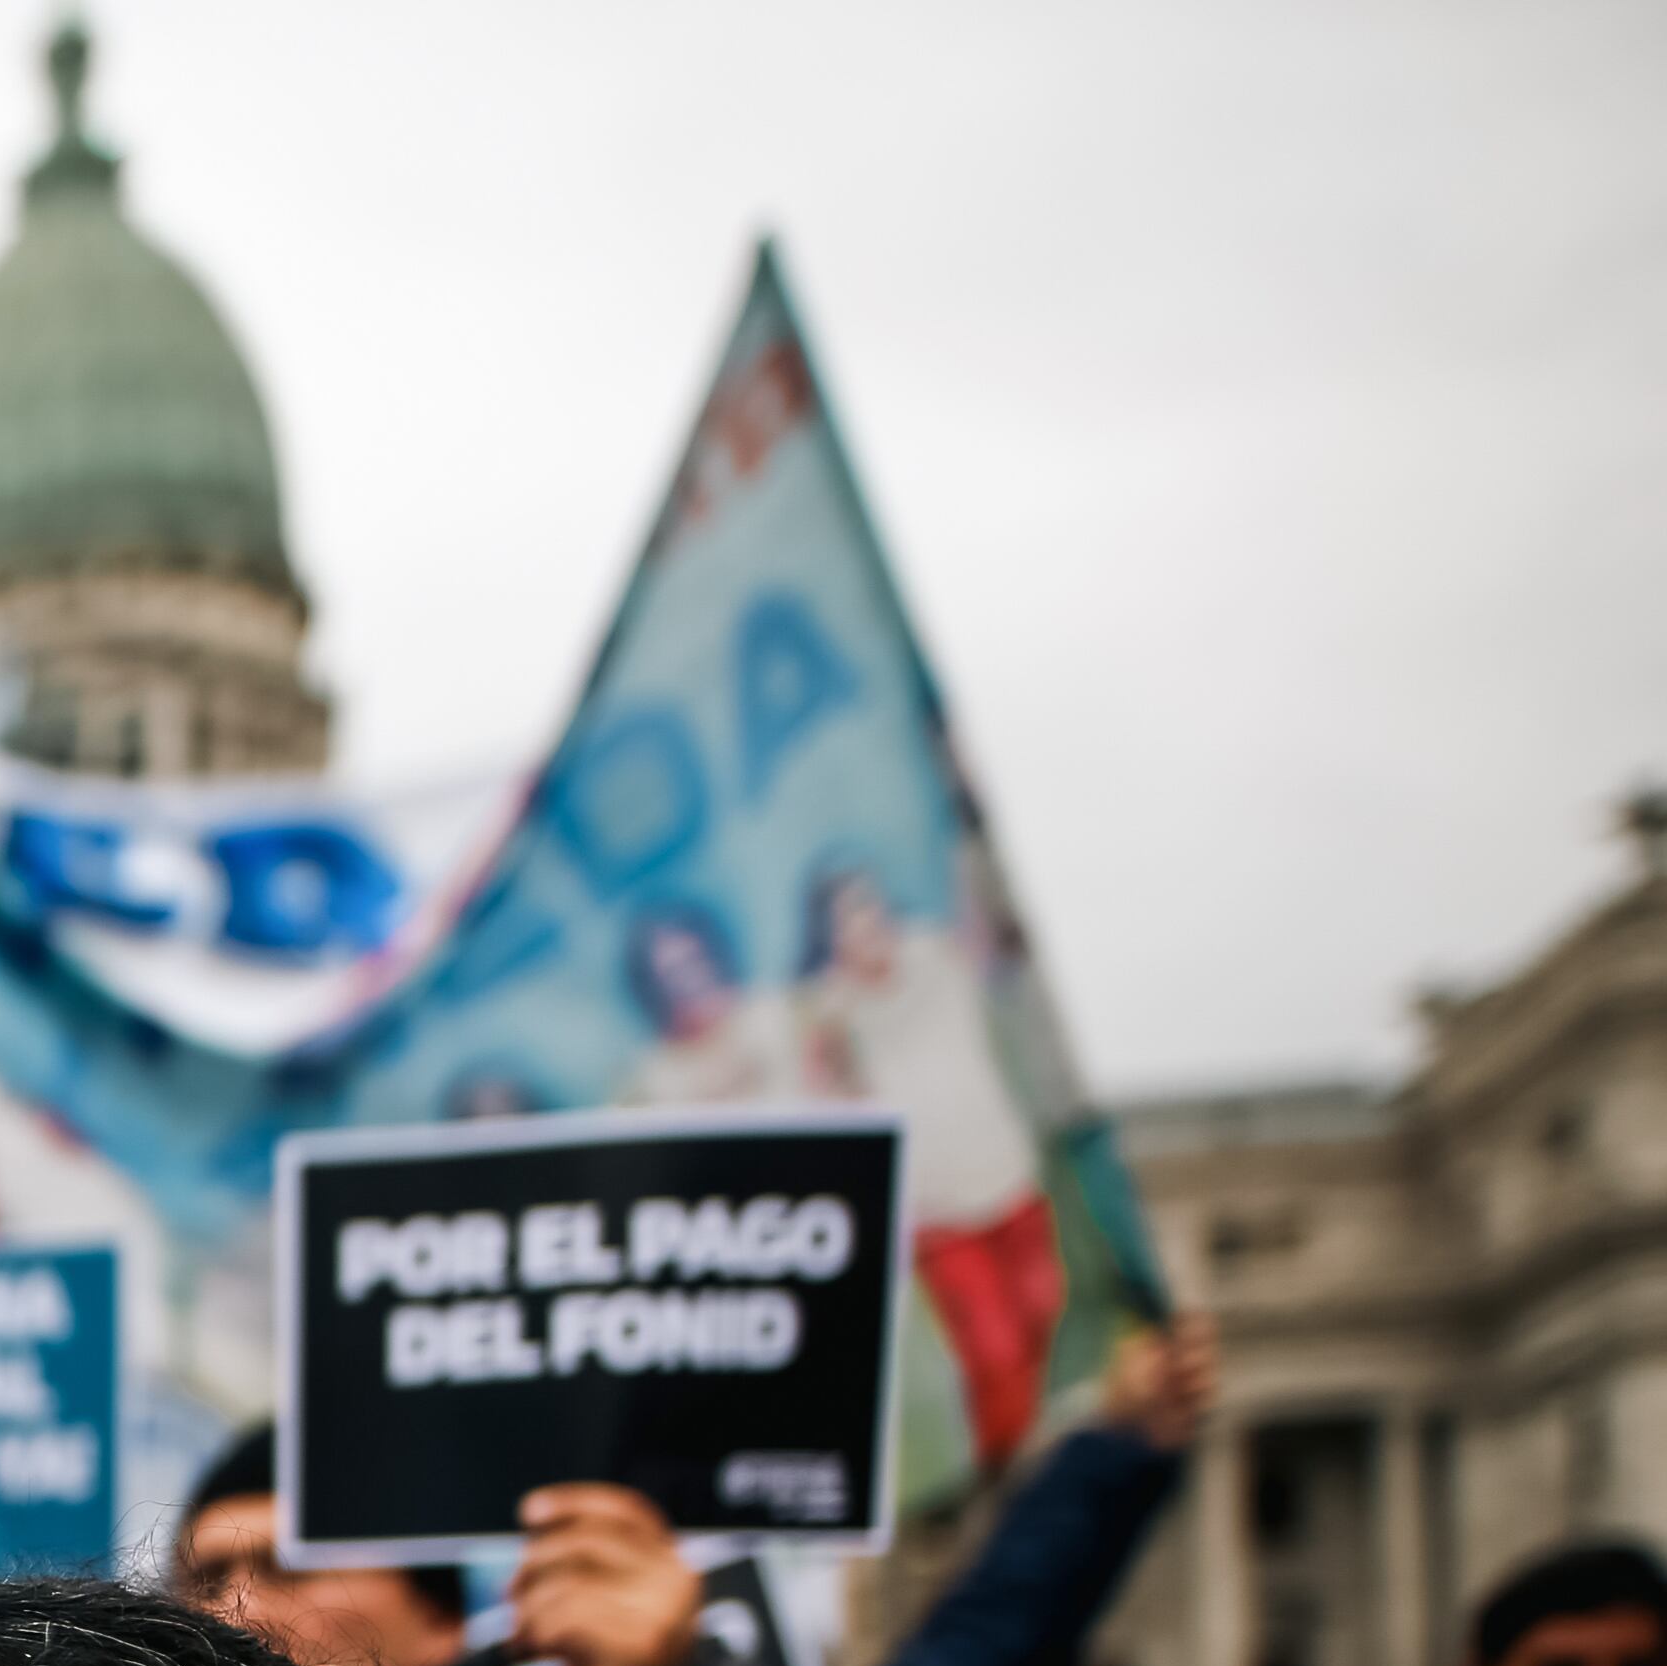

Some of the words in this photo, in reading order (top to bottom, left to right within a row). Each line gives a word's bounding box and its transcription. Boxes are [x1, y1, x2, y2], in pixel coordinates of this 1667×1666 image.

[337, 1207, 508, 1304] POR
[518, 1202, 620, 1290] EL
[628, 1194, 855, 1283] PAGO
[385, 1299, 544, 1388] DEL
[548, 1288, 804, 1377] FONID
